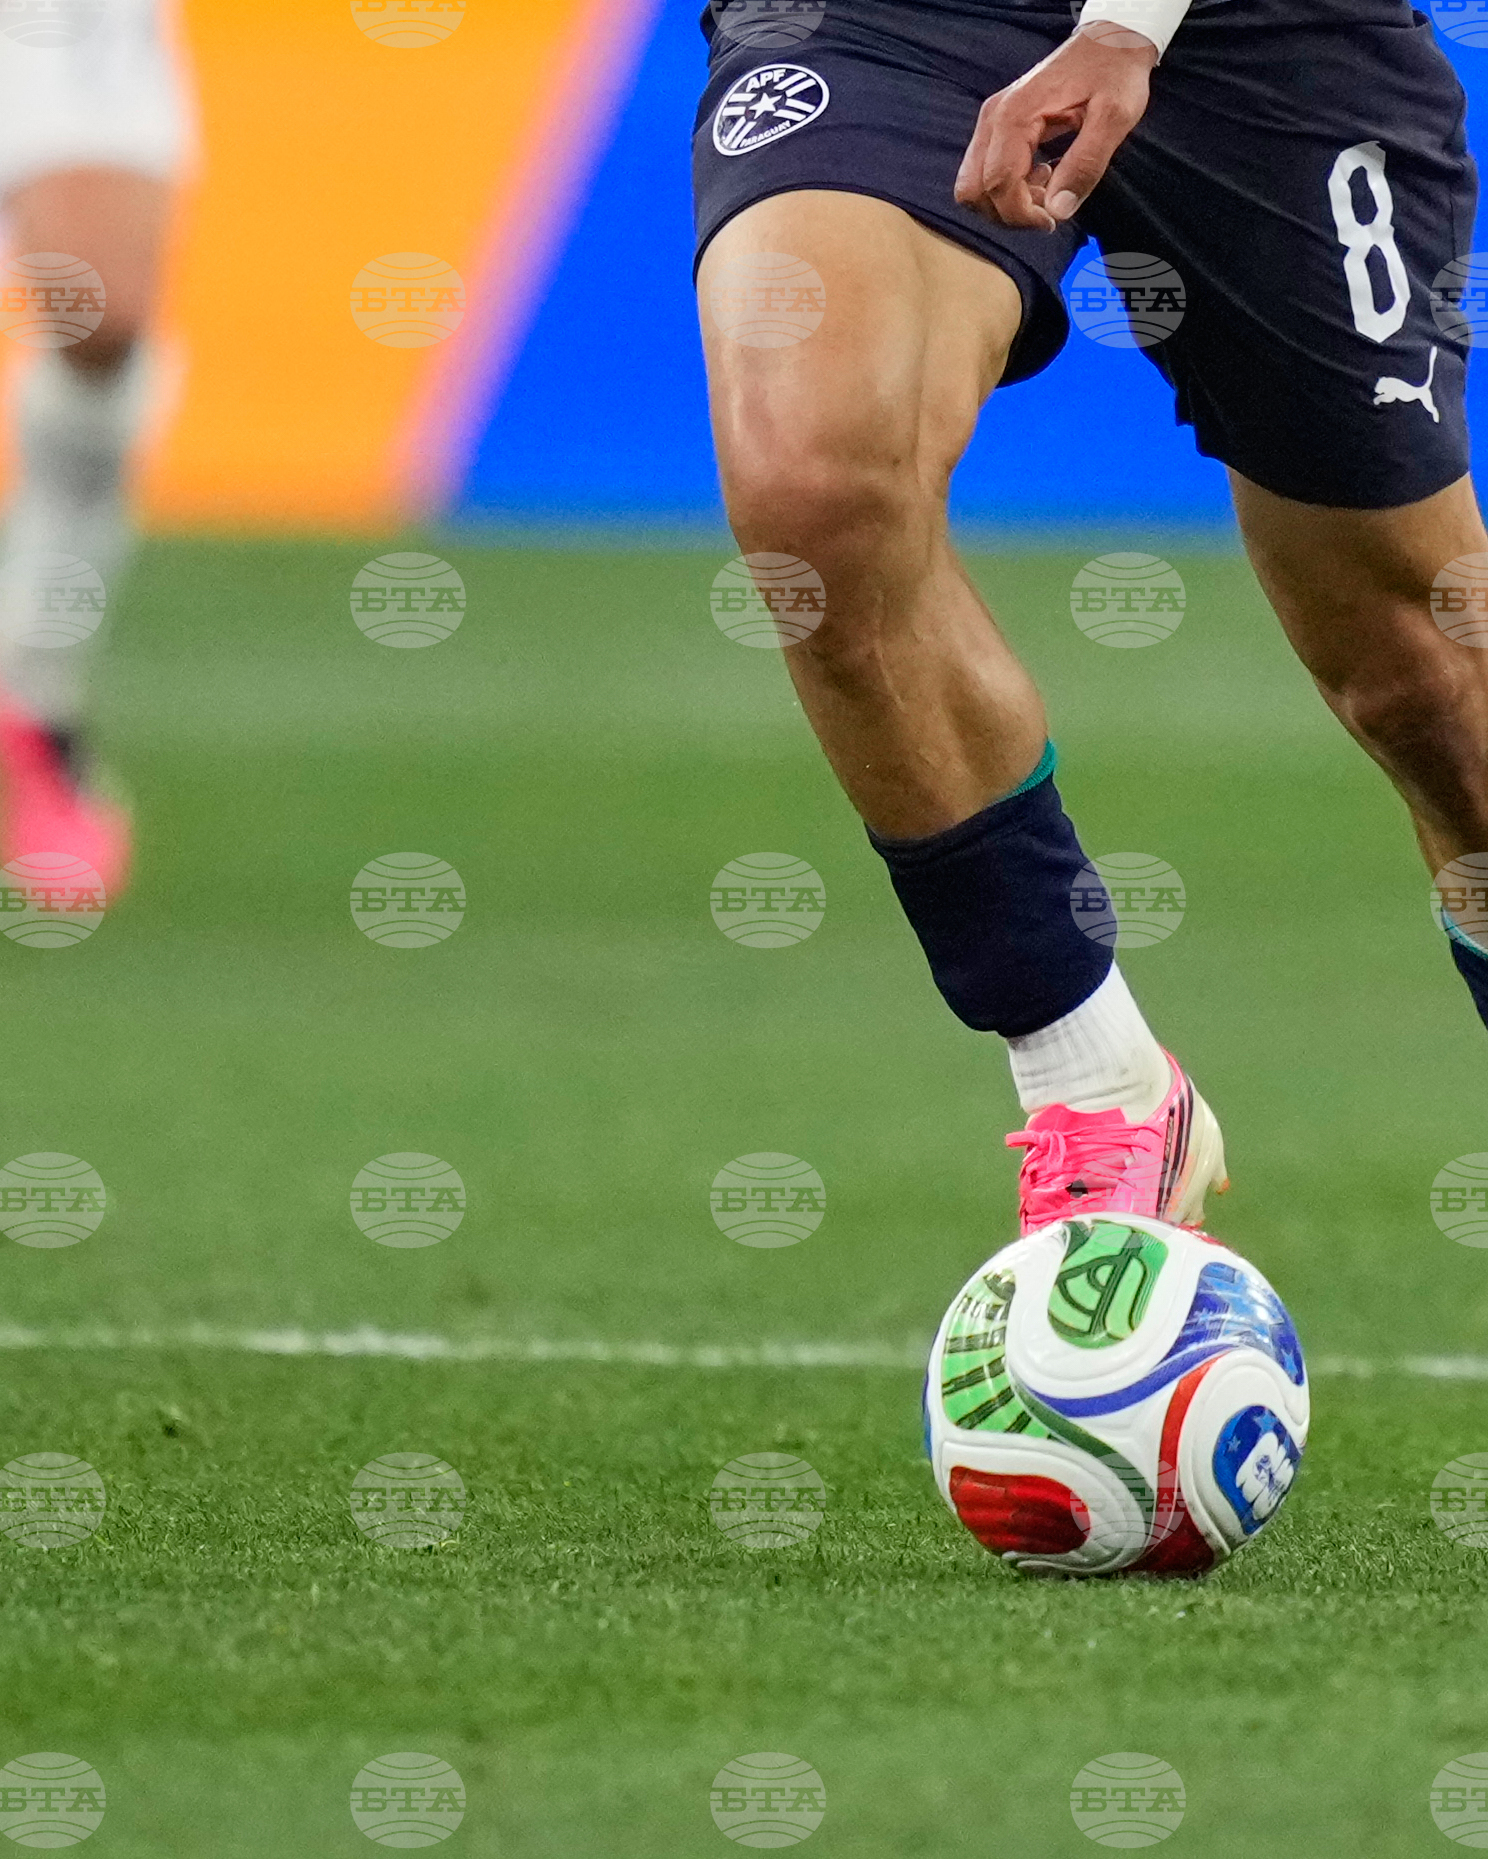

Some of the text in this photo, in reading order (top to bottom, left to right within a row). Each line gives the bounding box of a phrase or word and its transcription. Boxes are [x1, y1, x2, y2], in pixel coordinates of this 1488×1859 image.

[745, 69, 787, 93] APF
[739, 120, 792, 148] PARAGUAY
[1327, 140, 1412, 343] 8
